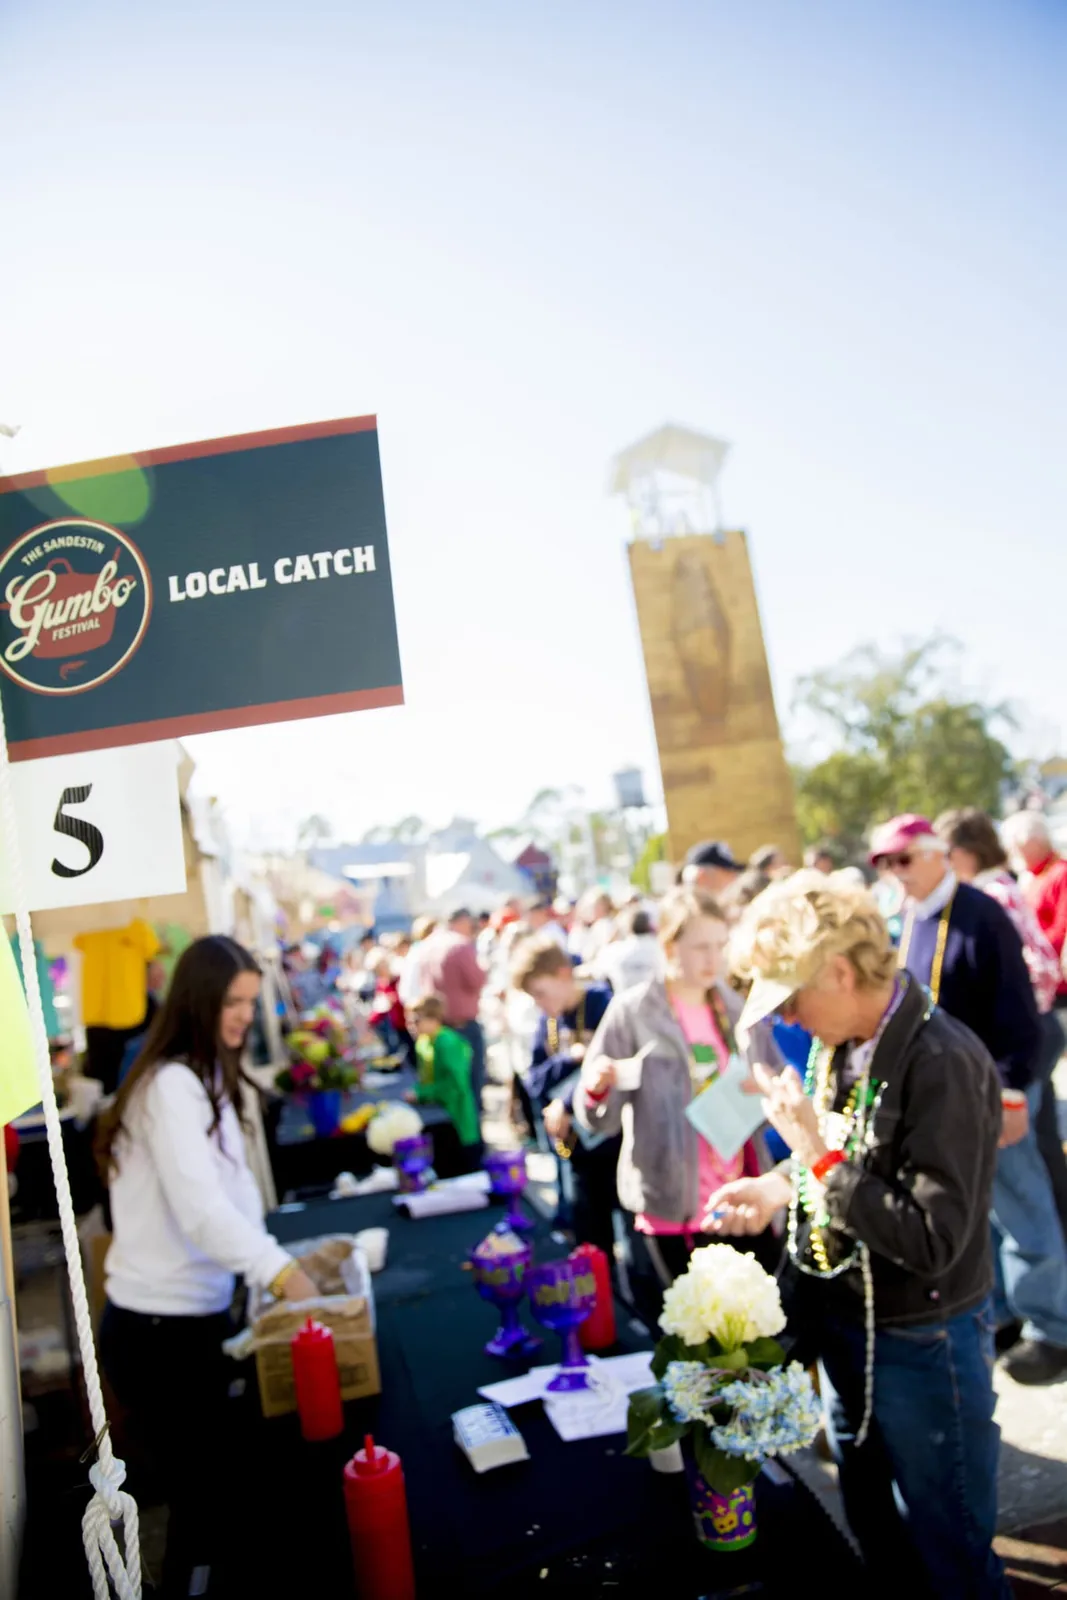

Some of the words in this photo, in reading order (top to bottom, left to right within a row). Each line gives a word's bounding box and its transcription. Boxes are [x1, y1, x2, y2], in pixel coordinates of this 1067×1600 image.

[20, 546, 44, 566] THE
[43, 535, 105, 555] SANDESTIN
[168, 562, 267, 602] LOCAL
[274, 545, 376, 584] CATCH
[4, 560, 137, 661] Gumbo
[52, 617, 101, 641] FESTIVAL
[51, 783, 104, 878] 5
